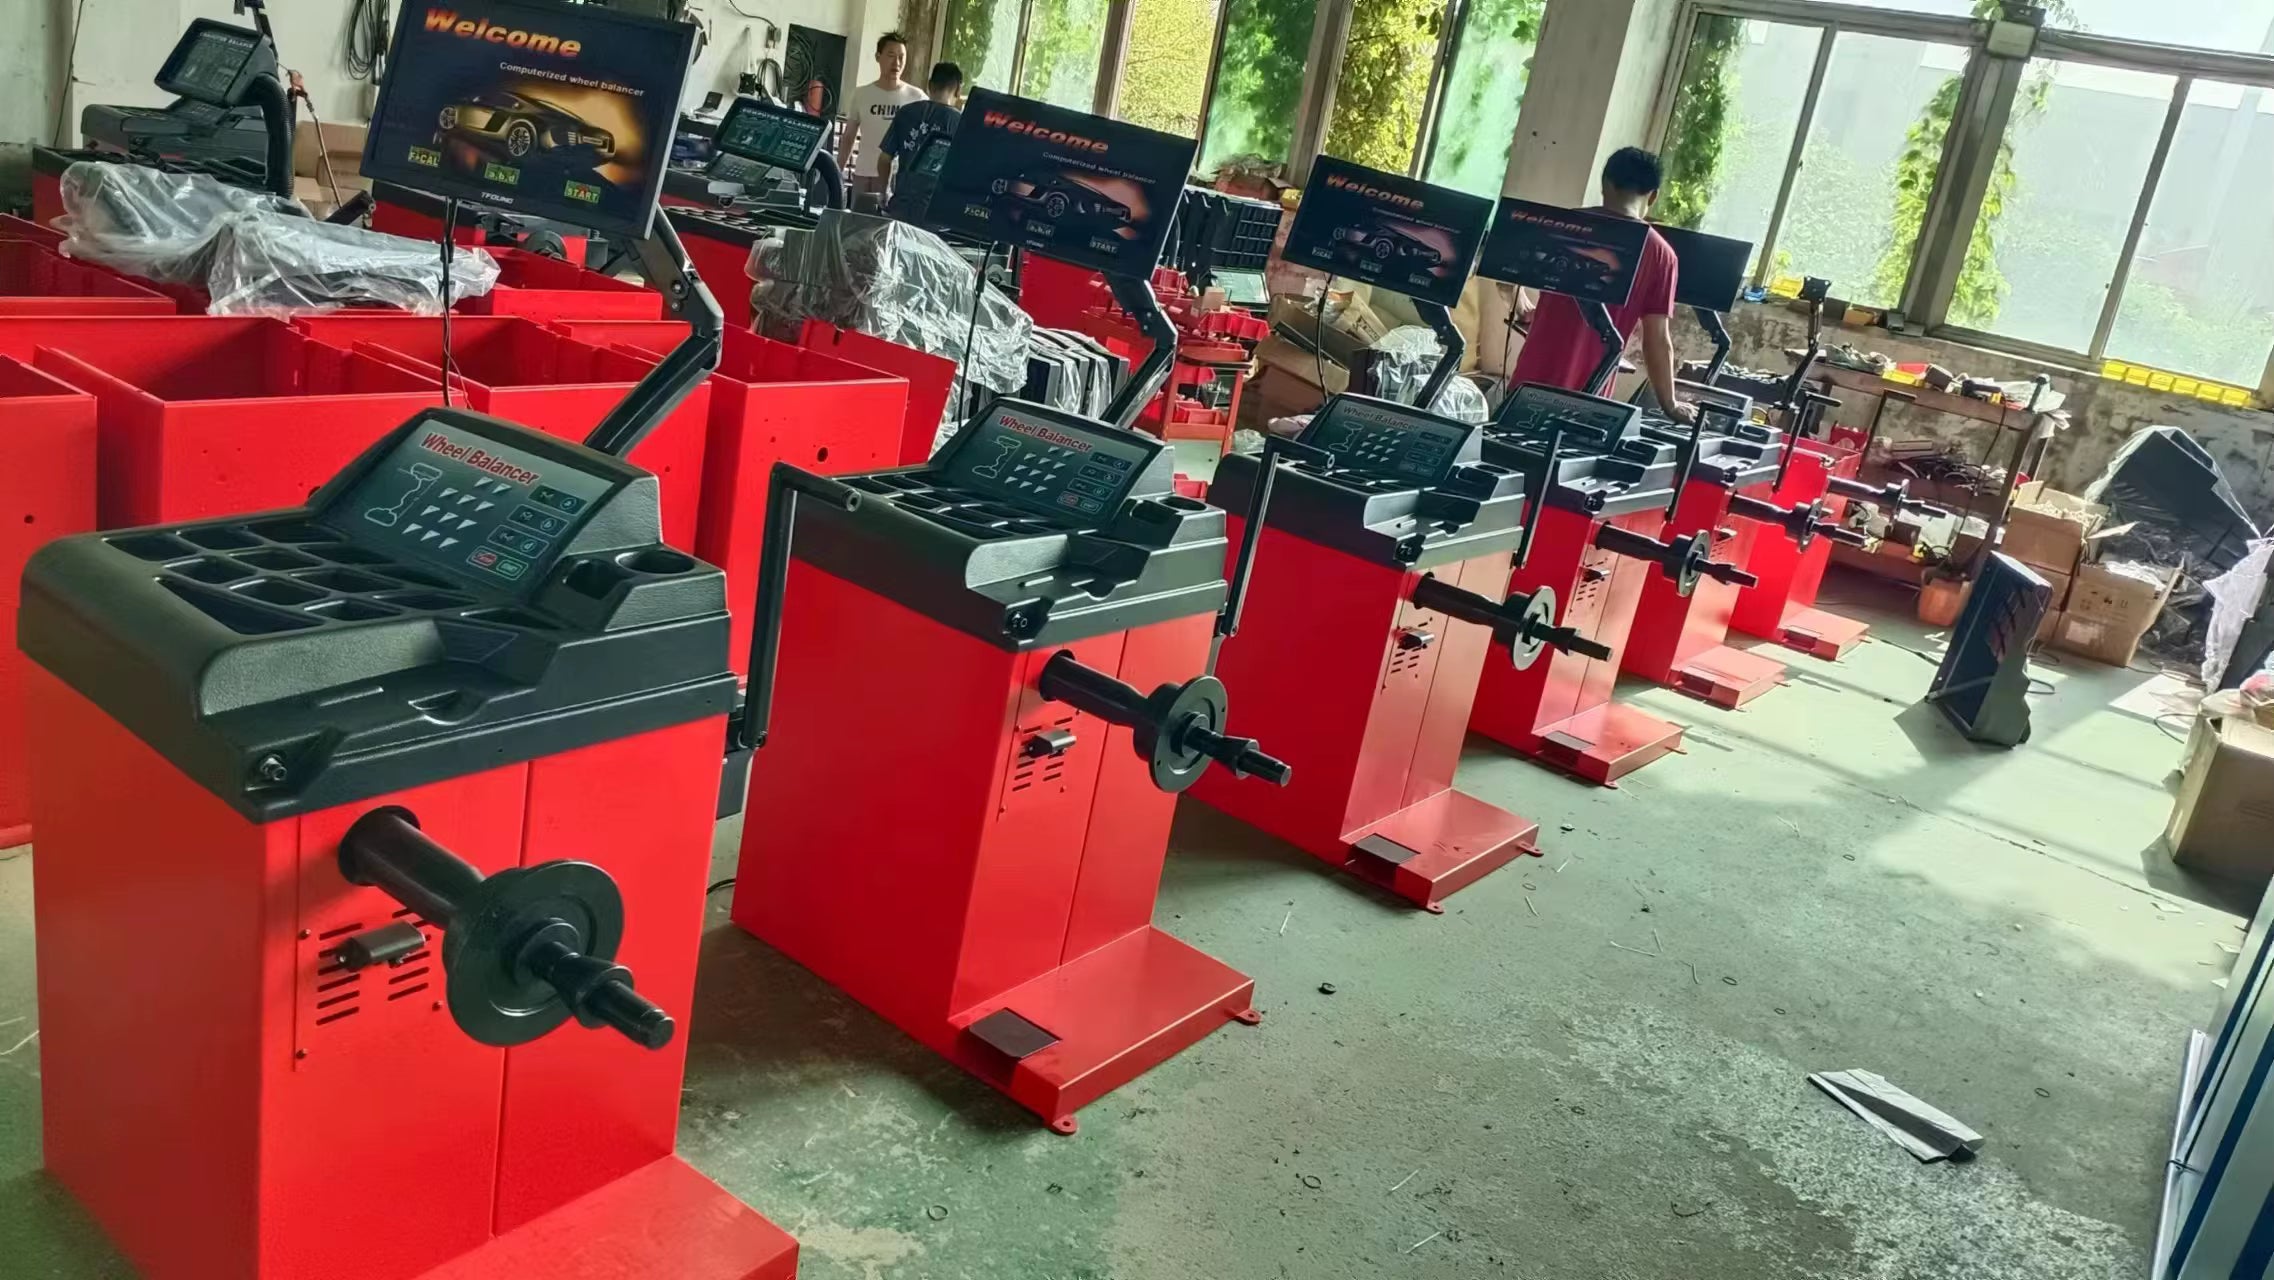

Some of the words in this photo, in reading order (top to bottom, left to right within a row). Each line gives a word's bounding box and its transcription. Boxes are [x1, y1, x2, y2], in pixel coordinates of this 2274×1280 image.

[424, 7, 582, 58] Welcome
[500, 62, 567, 82] Computerized
[569, 76, 598, 88] wheel
[601, 82, 644, 97] balancer
[984, 111, 1109, 153] Welcome
[1042, 151, 1096, 170] Computerized
[566, 186, 599, 202] START
[1327, 174, 1424, 210] Welcome
[999, 414, 1037, 436] Wheel
[1036, 426, 1093, 453] Balancer
[420, 432, 473, 461] Wheel
[466, 449, 540, 486] Balancer
